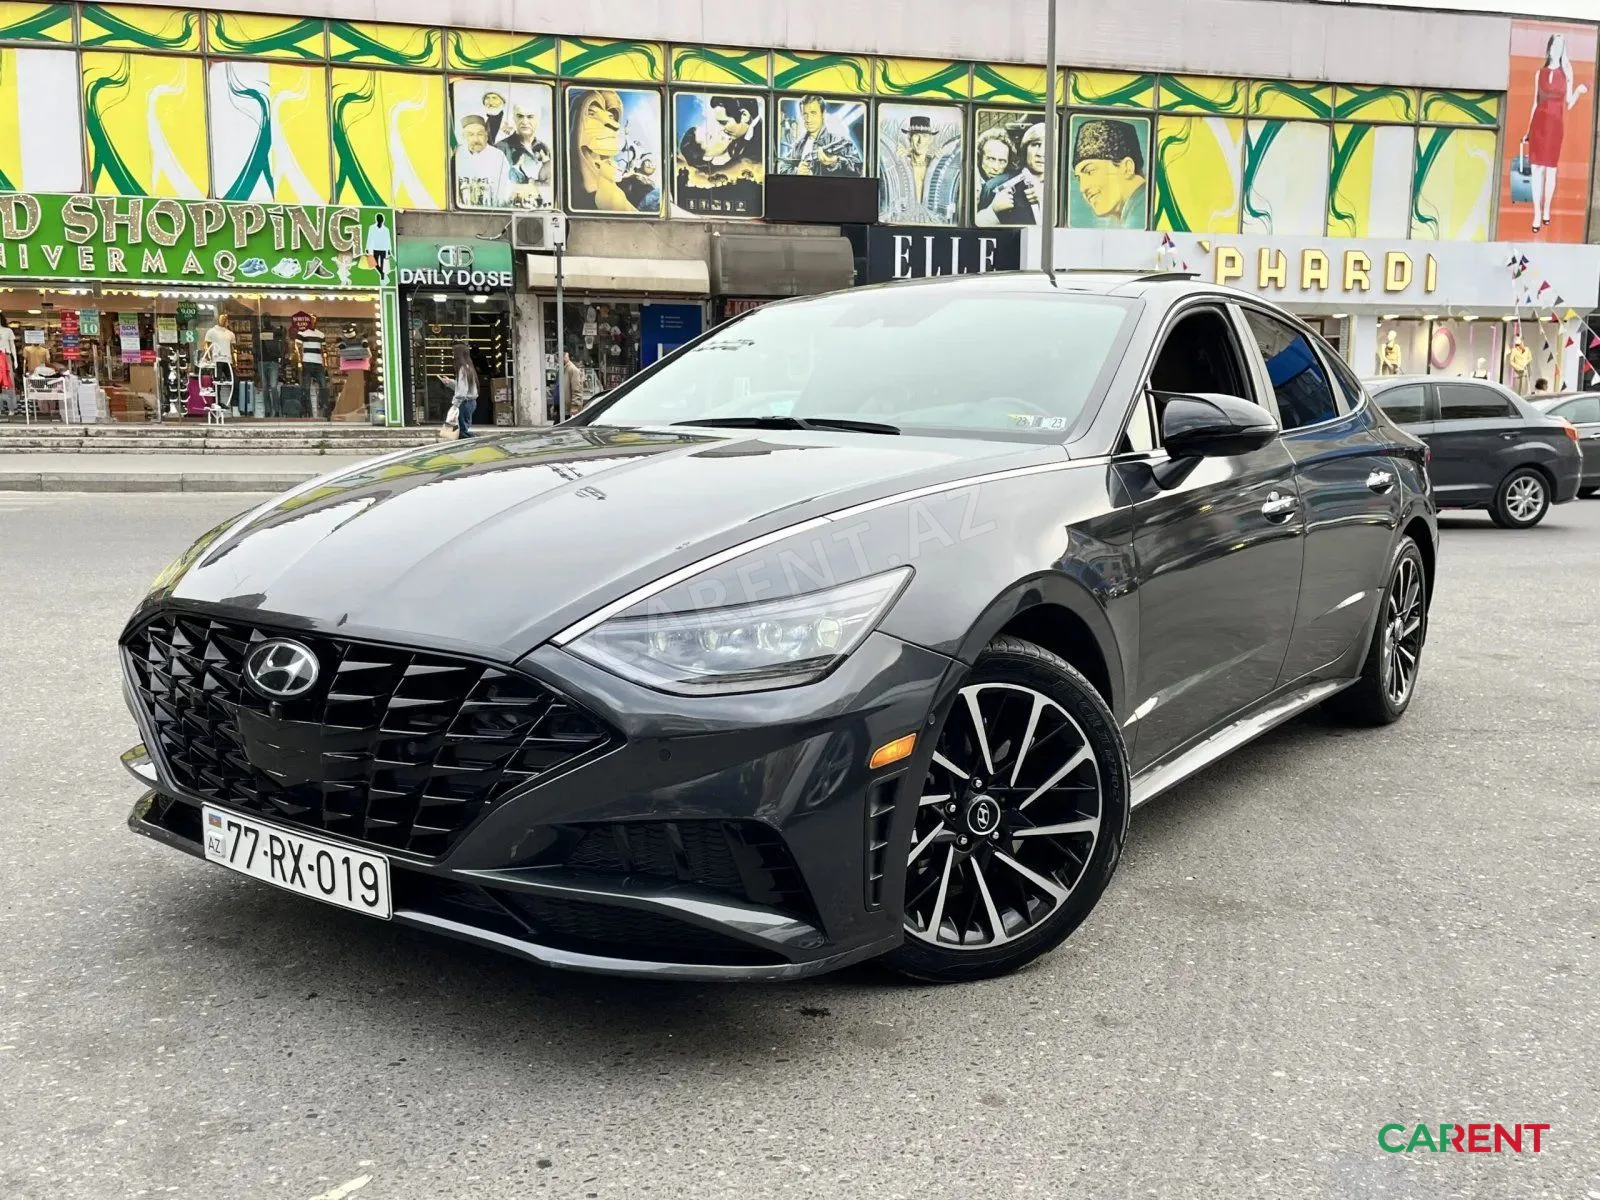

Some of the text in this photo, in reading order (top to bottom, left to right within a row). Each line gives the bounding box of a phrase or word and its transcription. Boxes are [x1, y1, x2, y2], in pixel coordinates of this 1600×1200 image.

[893, 235, 996, 278] ELLE
[400, 268, 513, 287] DAILY DOSE
[83, 323, 98, 334] 10
[186, 330, 194, 342] 8
[208, 838, 221, 854] AZ
[227, 820, 379, 907] 77-RX-019
